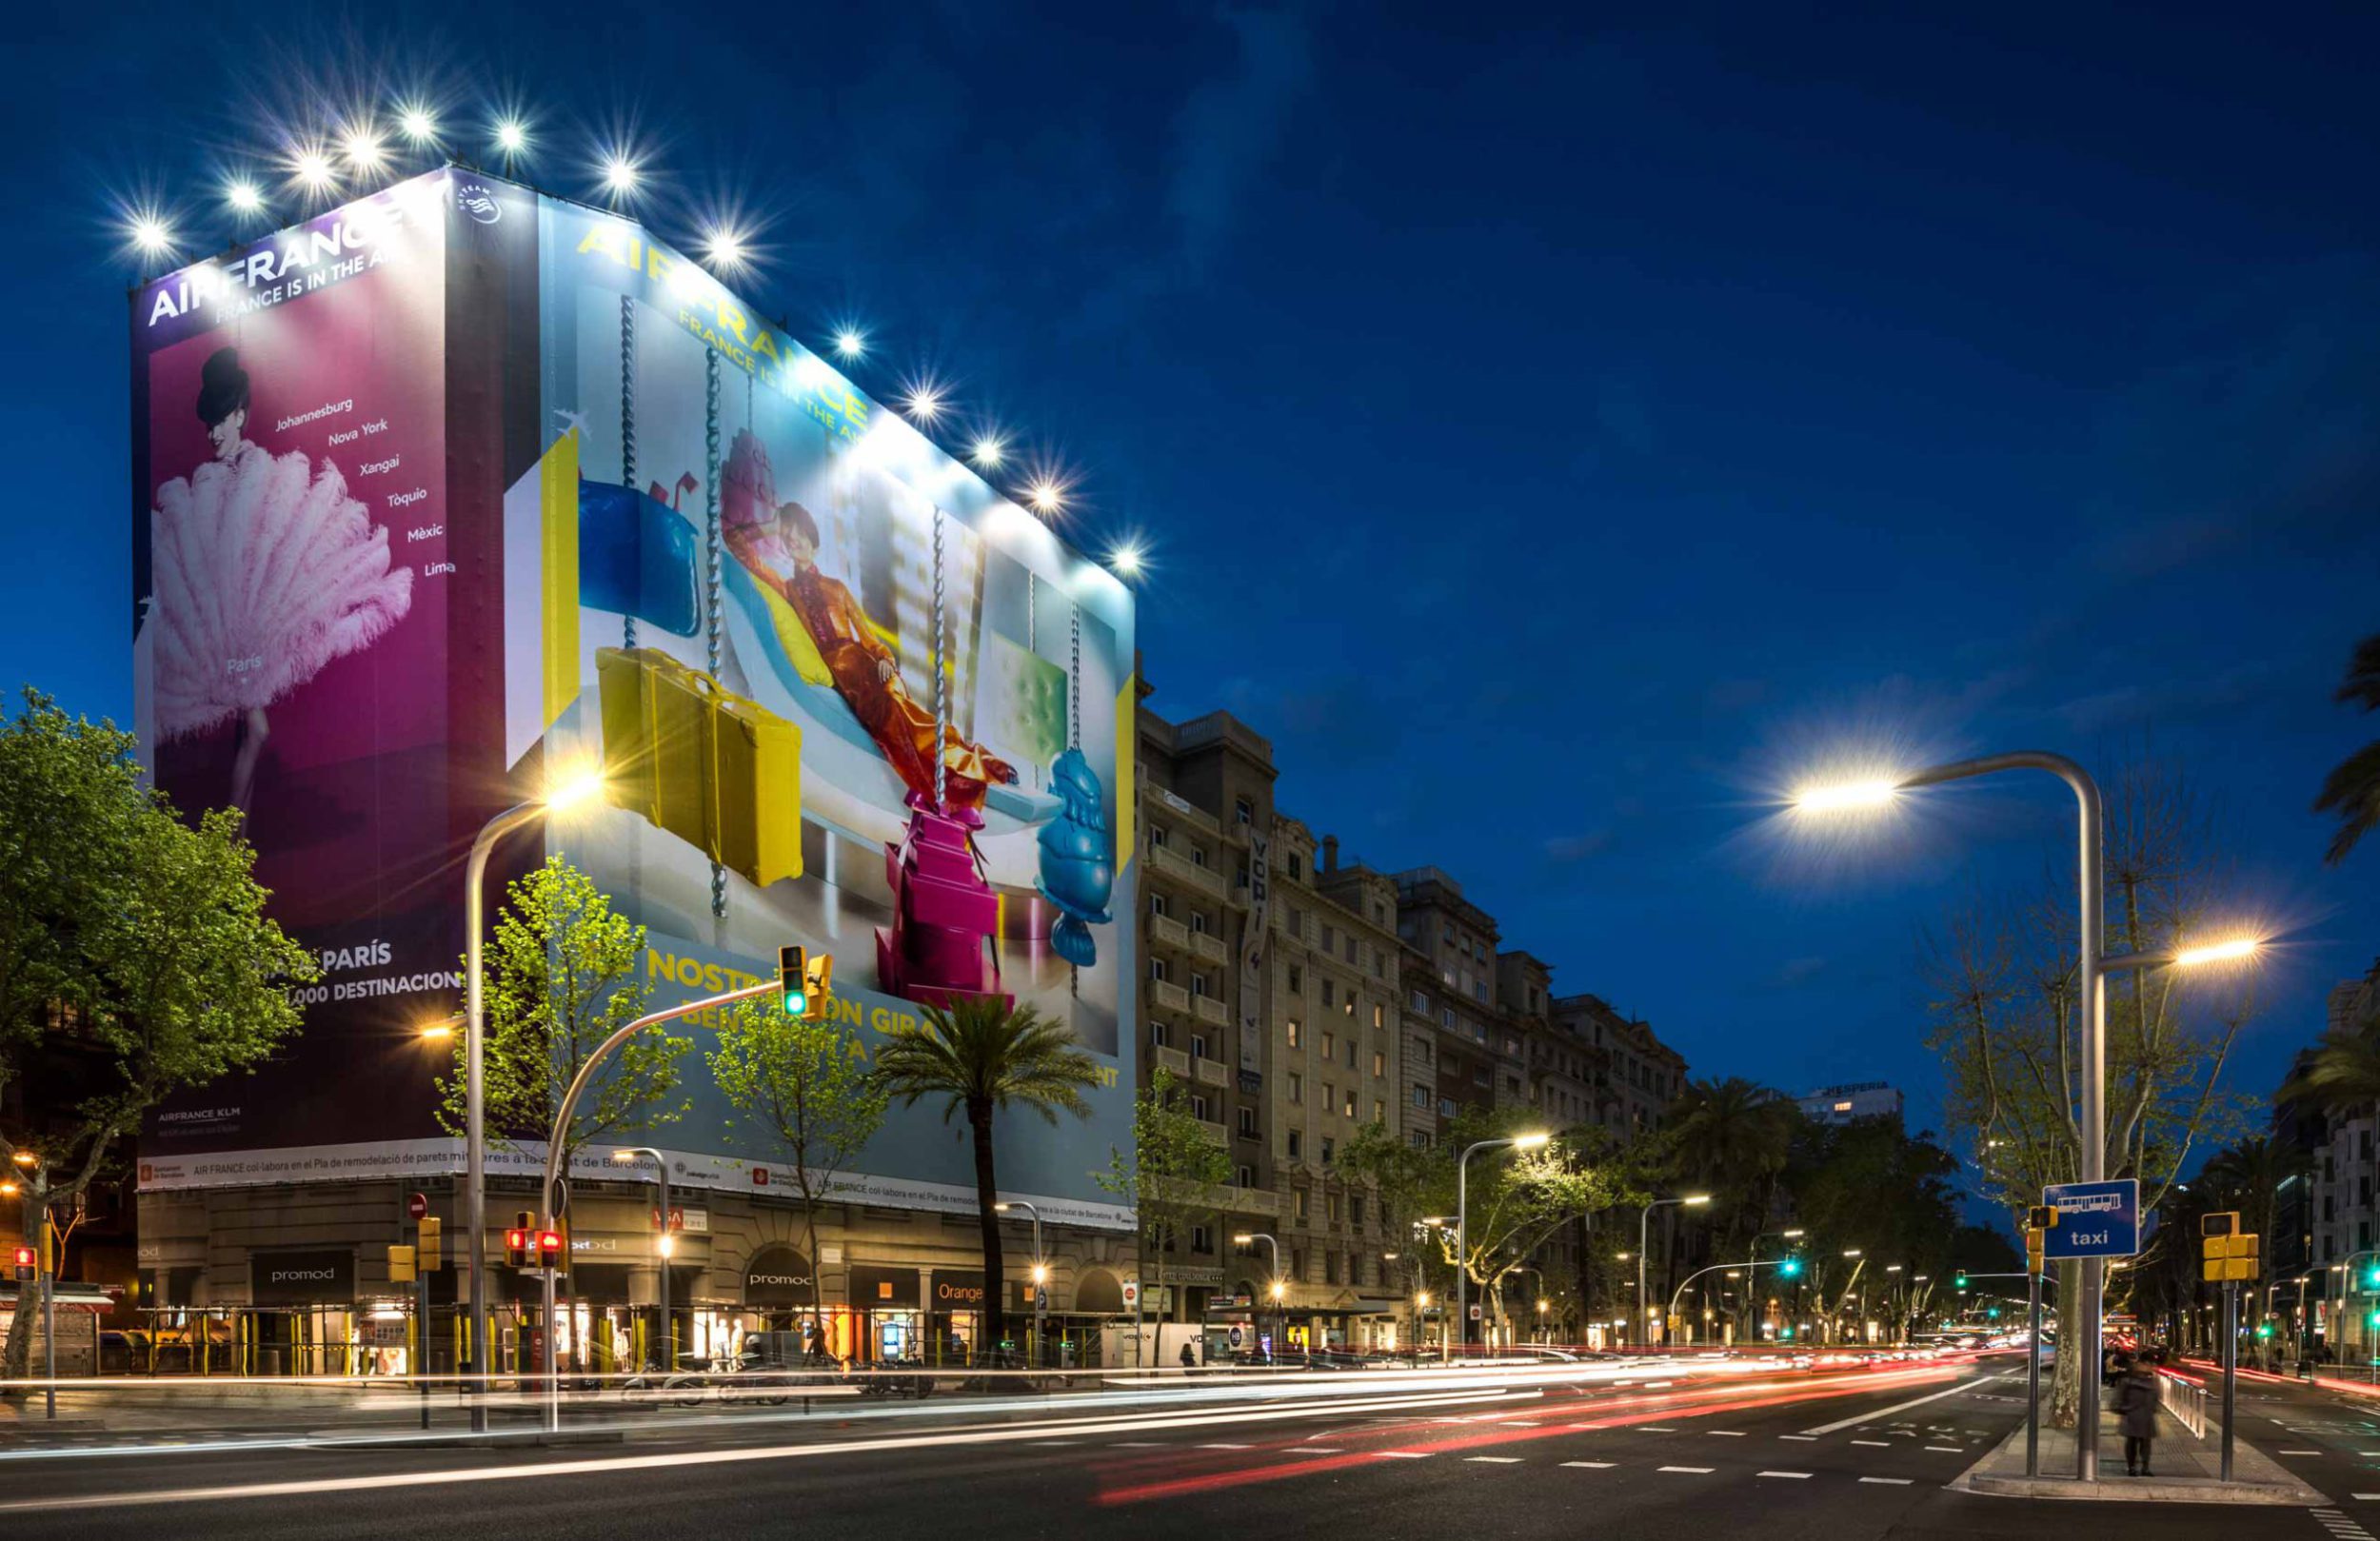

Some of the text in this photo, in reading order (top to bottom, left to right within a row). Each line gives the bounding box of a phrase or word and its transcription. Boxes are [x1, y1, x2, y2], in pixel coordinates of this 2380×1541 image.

[215, 285, 283, 324] FRANCE
[287, 281, 302, 299] IS
[307, 268, 327, 291] IN
[330, 255, 365, 281] THE
[678, 309, 755, 374] FRANCE
[760, 367, 777, 385] IS
[782, 383, 807, 405] IN
[805, 402, 836, 430] THE
[275, 398, 353, 432] Johannesburg
[328, 418, 388, 447] Nova York
[359, 454, 400, 477] Xangai
[387, 487, 427, 507] Tòquio
[407, 524, 444, 543] Mèxic
[425, 562, 457, 577] Lima
[322, 938, 392, 972] PARÍS
[333, 970, 466, 1001] DESTINACION
[158, 1107, 241, 1123] AIRFRANCE KLM
[193, 1164, 208, 1176] AIR
[209, 1162, 246, 1175] FRANCE
[290, 1161, 302, 1171] en
[303, 1159, 312, 1170] el
[313, 1157, 328, 1170] Pla
[329, 1156, 342, 1169] de
[343, 1153, 401, 1167] remodelació
[403, 1153, 415, 1164] de
[416, 1151, 448, 1165] parets
[512, 1154, 522, 1164] a
[582, 1158, 599, 1169] de
[602, 1156, 662, 1171] Barcelon
[940, 1193, 949, 1202] de
[2071, 1230, 2109, 1246] taxi
[271, 1267, 335, 1283] promod
[939, 1283, 983, 1302] Orange
[1039, 1294, 1045, 1308] P
